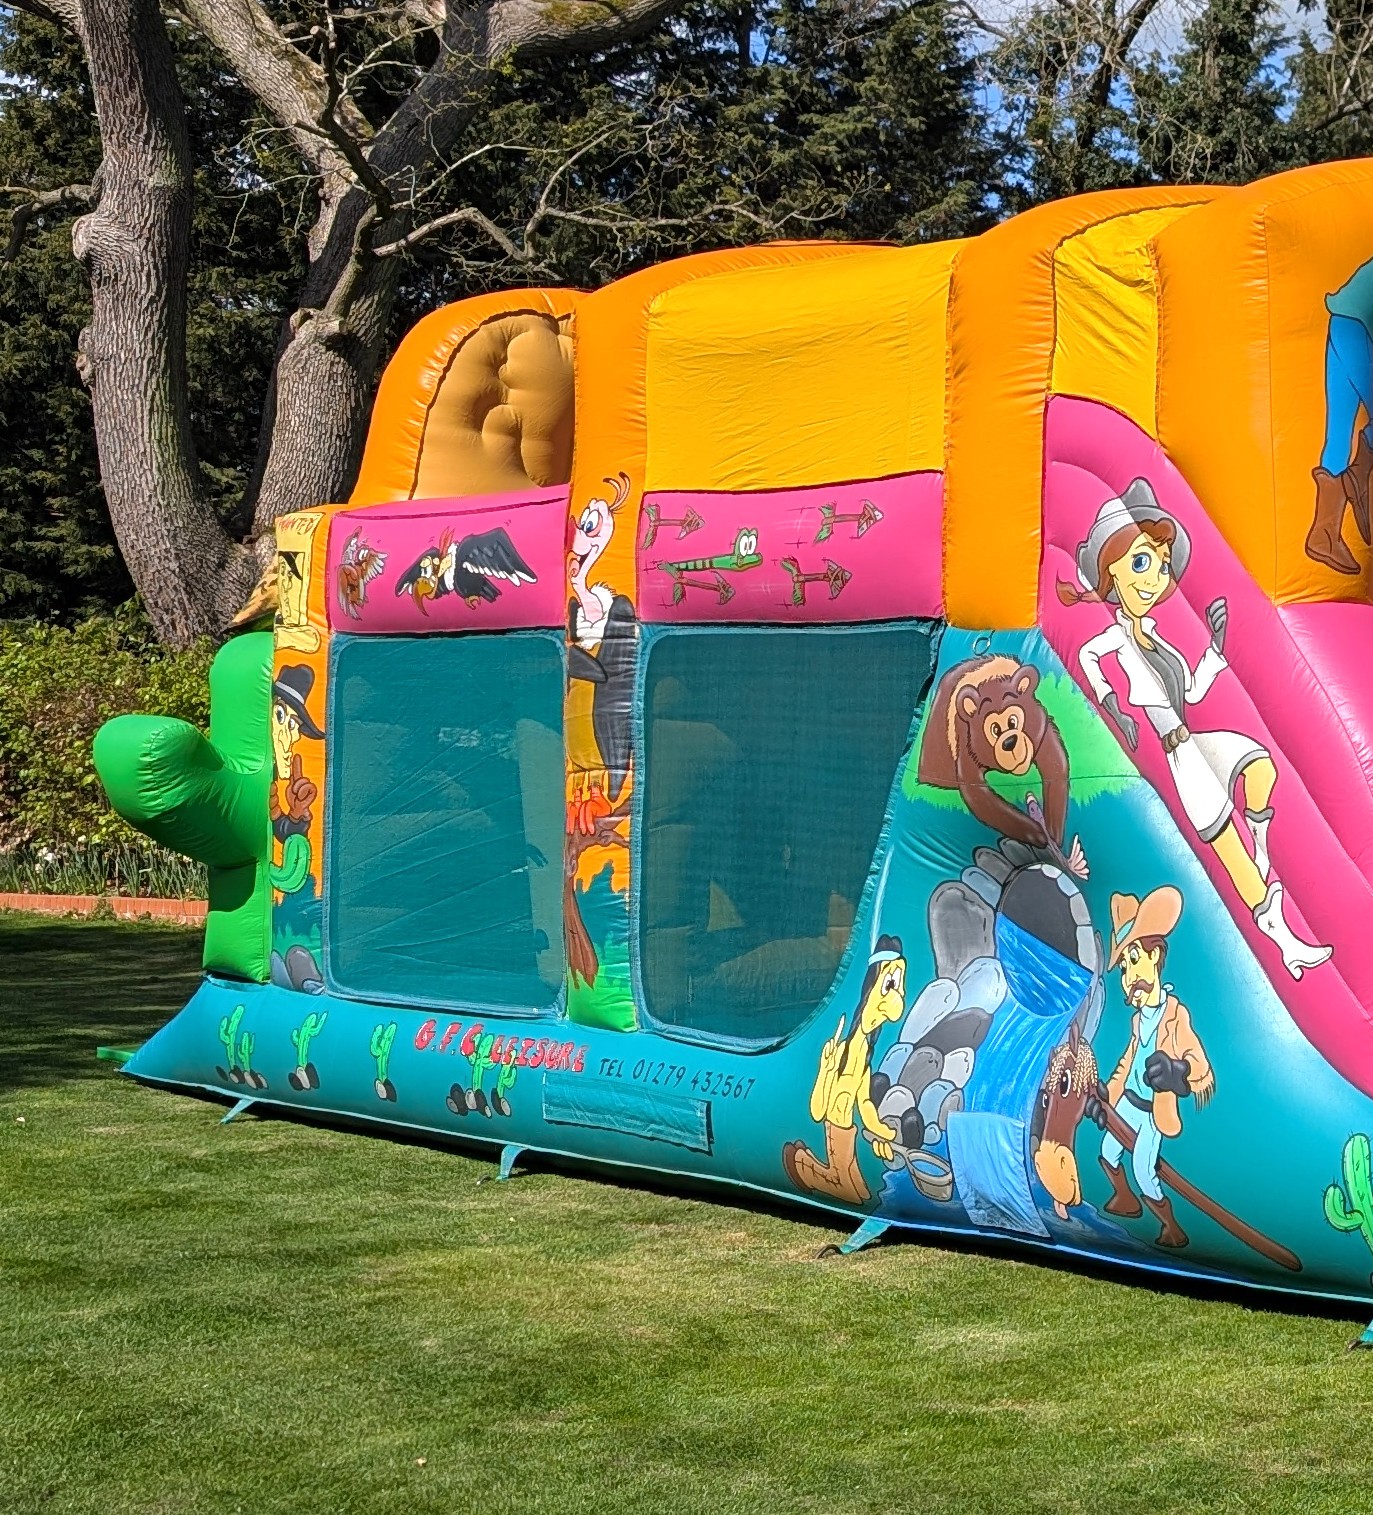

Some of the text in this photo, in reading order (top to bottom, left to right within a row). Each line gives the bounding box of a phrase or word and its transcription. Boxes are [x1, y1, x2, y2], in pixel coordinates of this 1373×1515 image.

[489, 1035, 588, 1073] LEISURE
[598, 1058, 756, 1100] TEL 01279 432567
